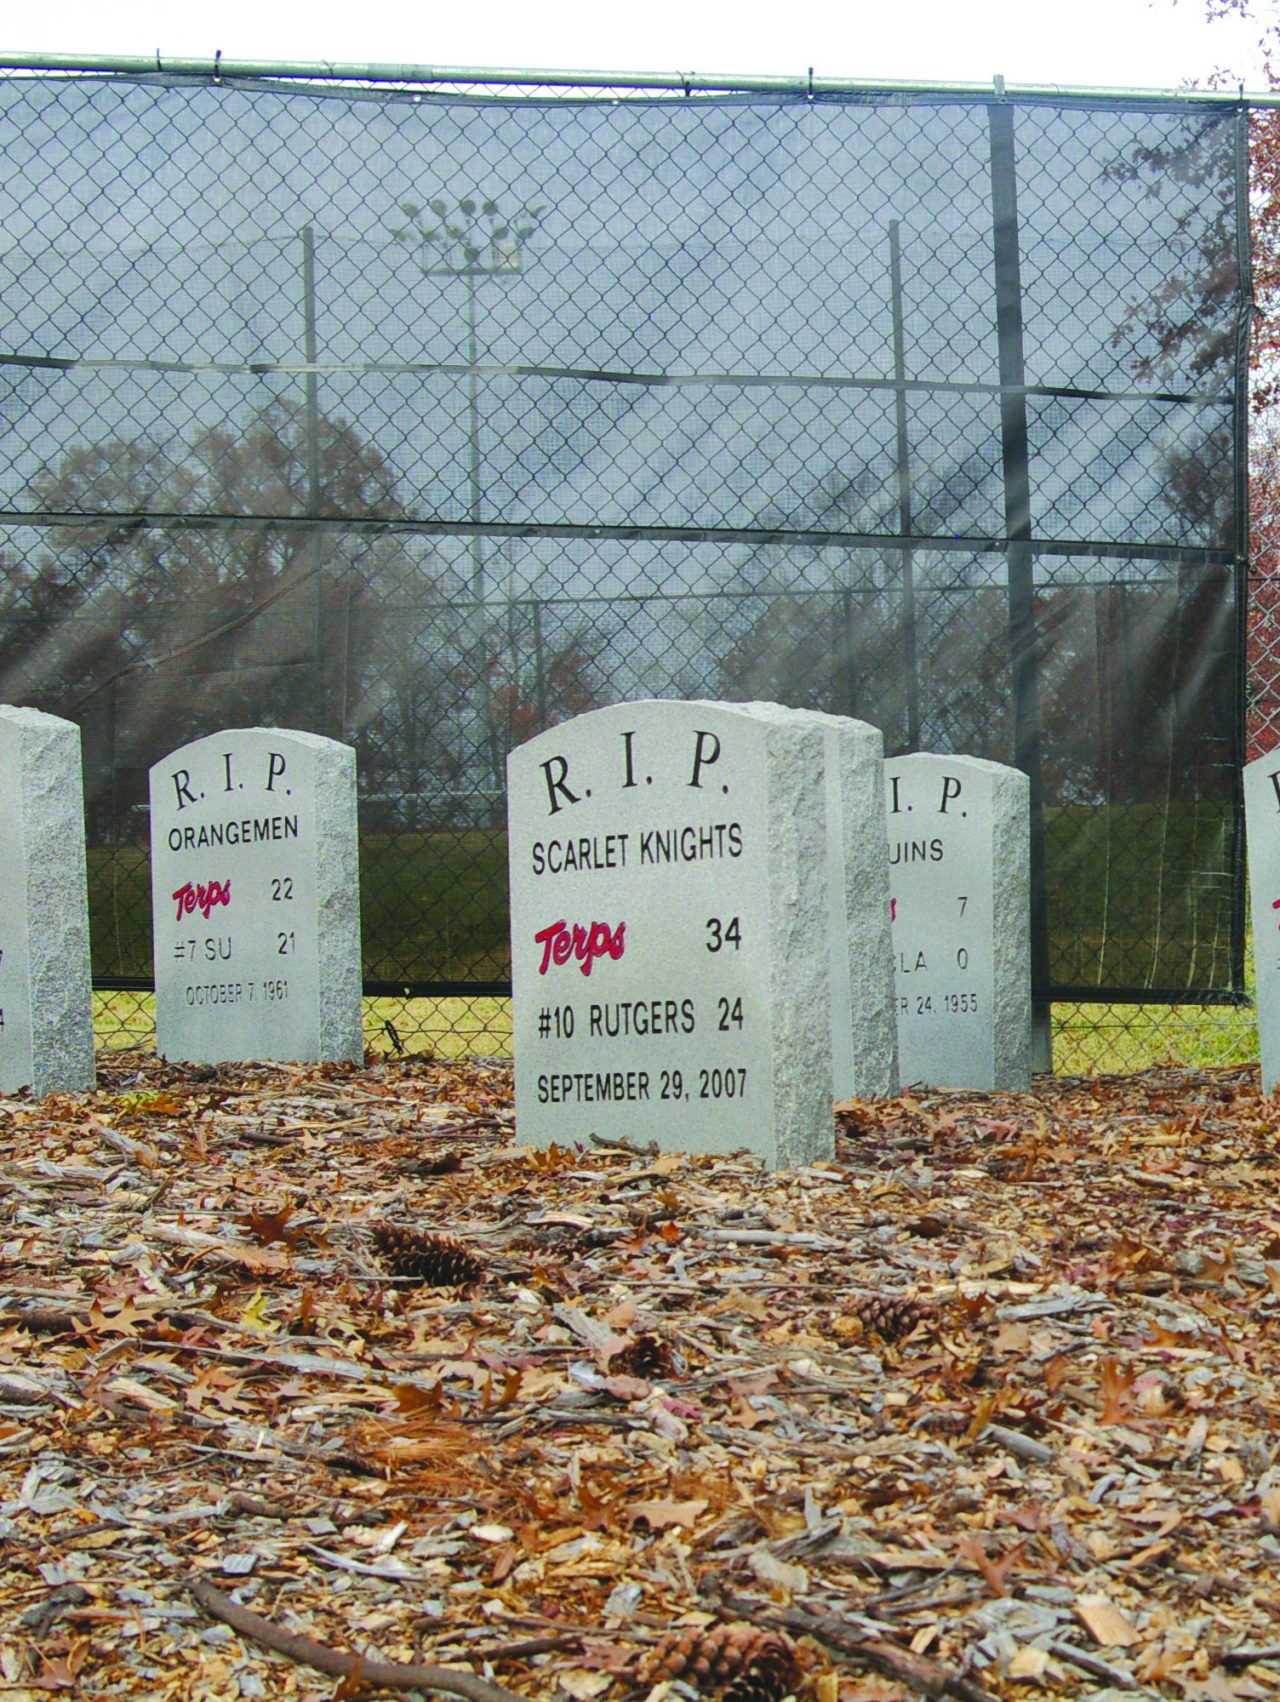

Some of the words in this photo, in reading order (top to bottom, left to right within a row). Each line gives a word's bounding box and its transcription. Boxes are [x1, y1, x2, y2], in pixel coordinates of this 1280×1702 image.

[168, 814, 298, 852] ORANGEMEN
[532, 833, 629, 876] SCARLET
[640, 822, 743, 865] KNIGHTS
[888, 838, 944, 865] UINS
[171, 879, 232, 922] Terps
[271, 876, 294, 902] 22
[957, 896, 968, 917] 7
[173, 940, 197, 962] #7
[204, 936, 232, 961] SU
[277, 931, 295, 955] 21
[534, 919, 627, 977] Terps
[705, 916, 742, 953] 34
[185, 983, 243, 1006] OCTOBER
[263, 979, 288, 1001] 1961
[944, 993, 978, 1014] 1955
[537, 1004, 575, 1040] #10
[589, 998, 696, 1038] RUTGERS
[717, 996, 744, 1032] 24
[537, 1071, 650, 1104] SEPTEMBER
[660, 1069, 690, 1103] 29,
[699, 1067, 747, 1099] 2007
